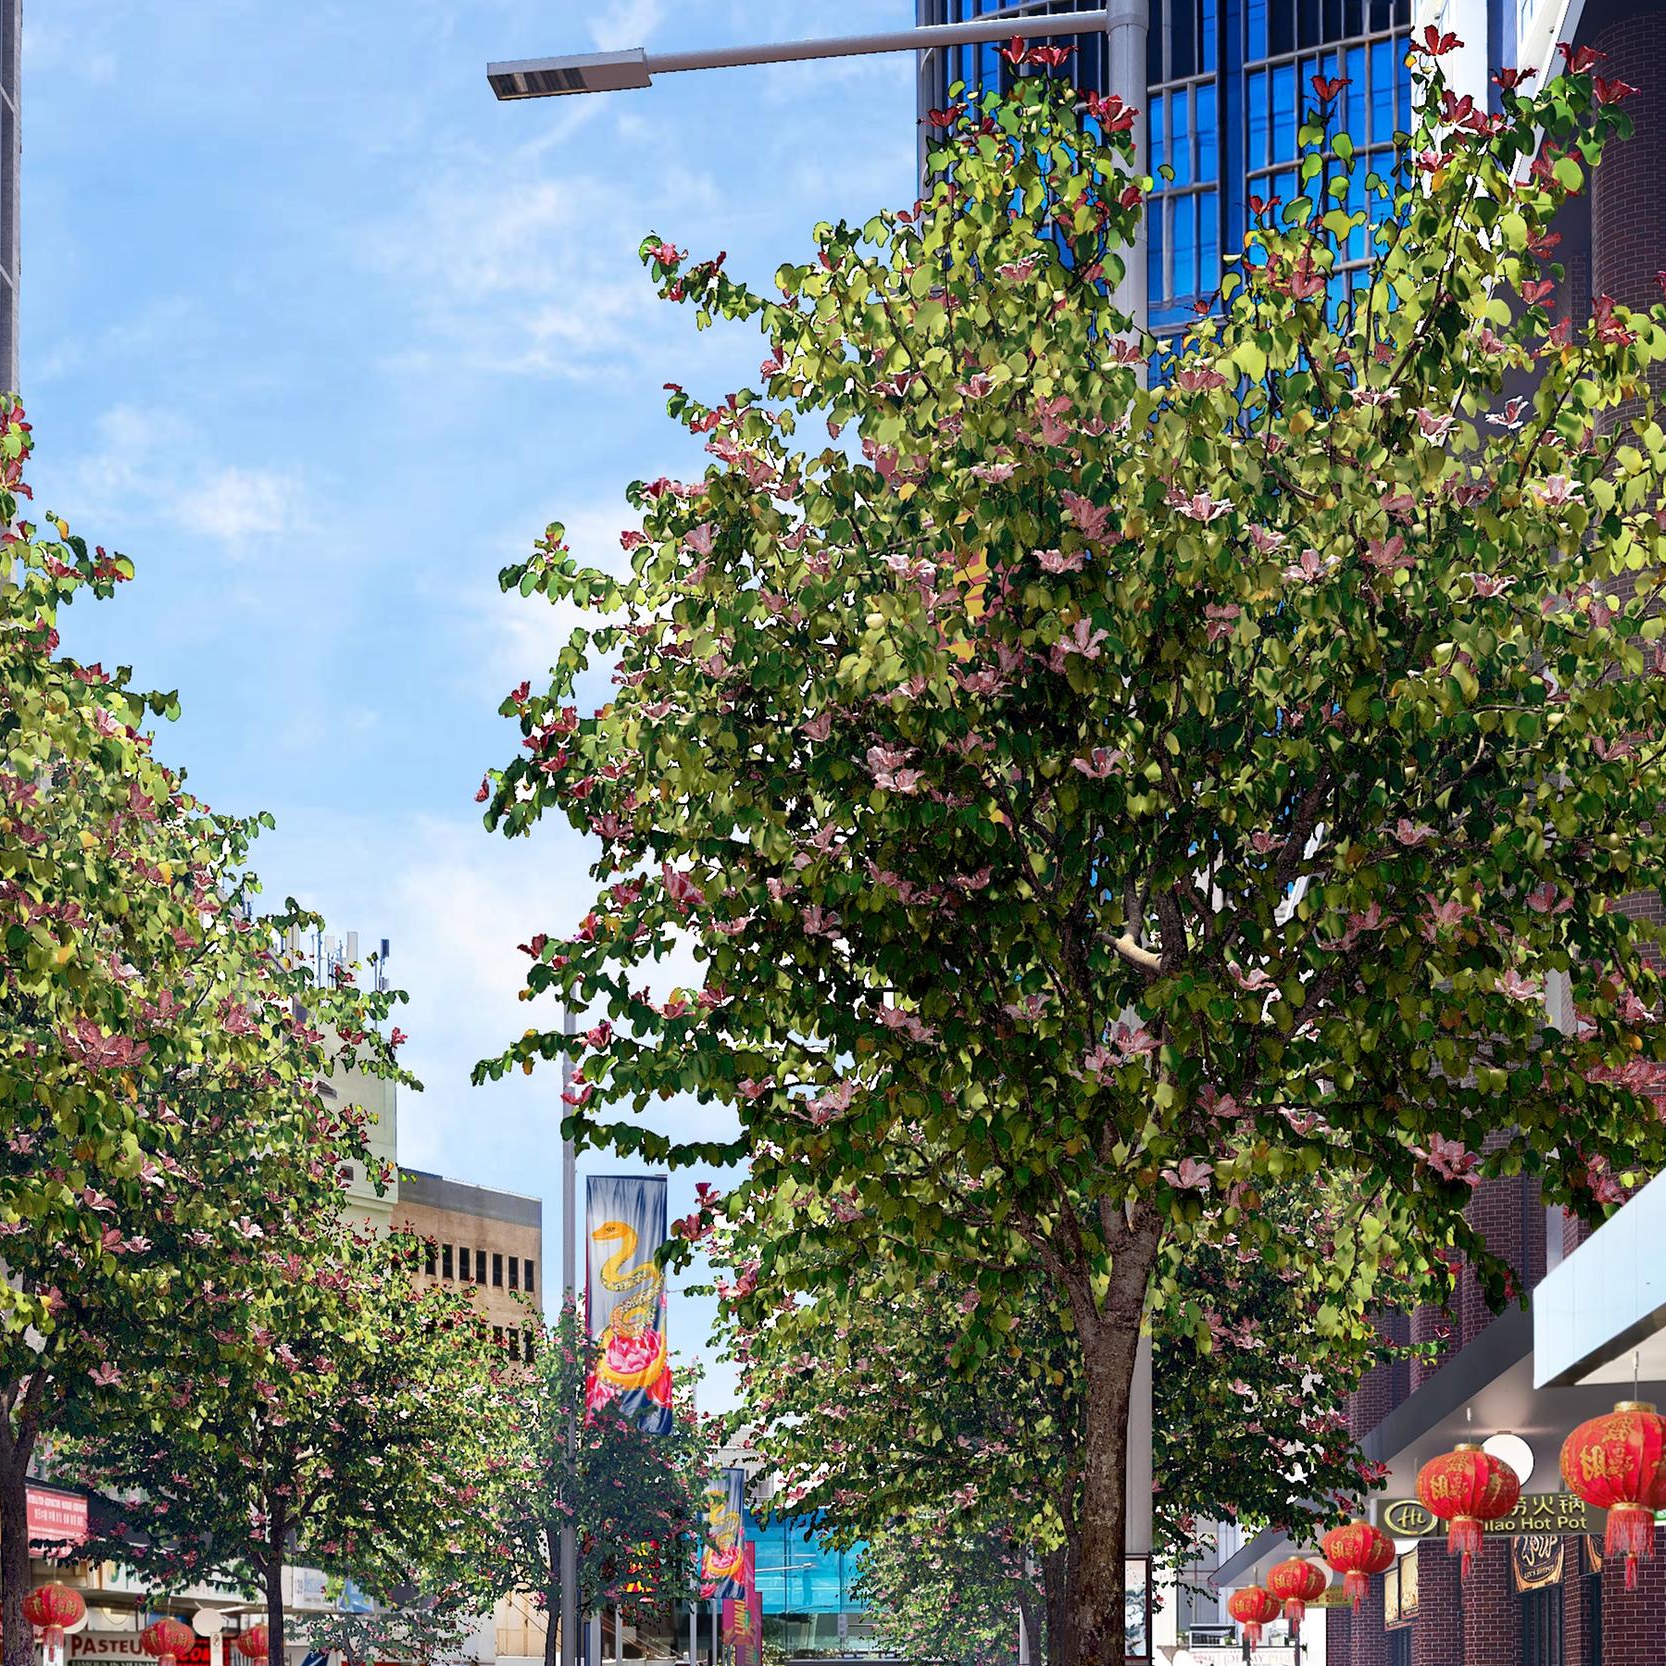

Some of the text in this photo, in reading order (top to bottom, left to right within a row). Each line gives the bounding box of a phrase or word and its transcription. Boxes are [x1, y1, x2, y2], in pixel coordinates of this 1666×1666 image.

[1520, 1516, 1552, 1531] Hot
[1558, 1515, 1587, 1530] Pot
[71, 1633, 157, 1659] PASTEU
